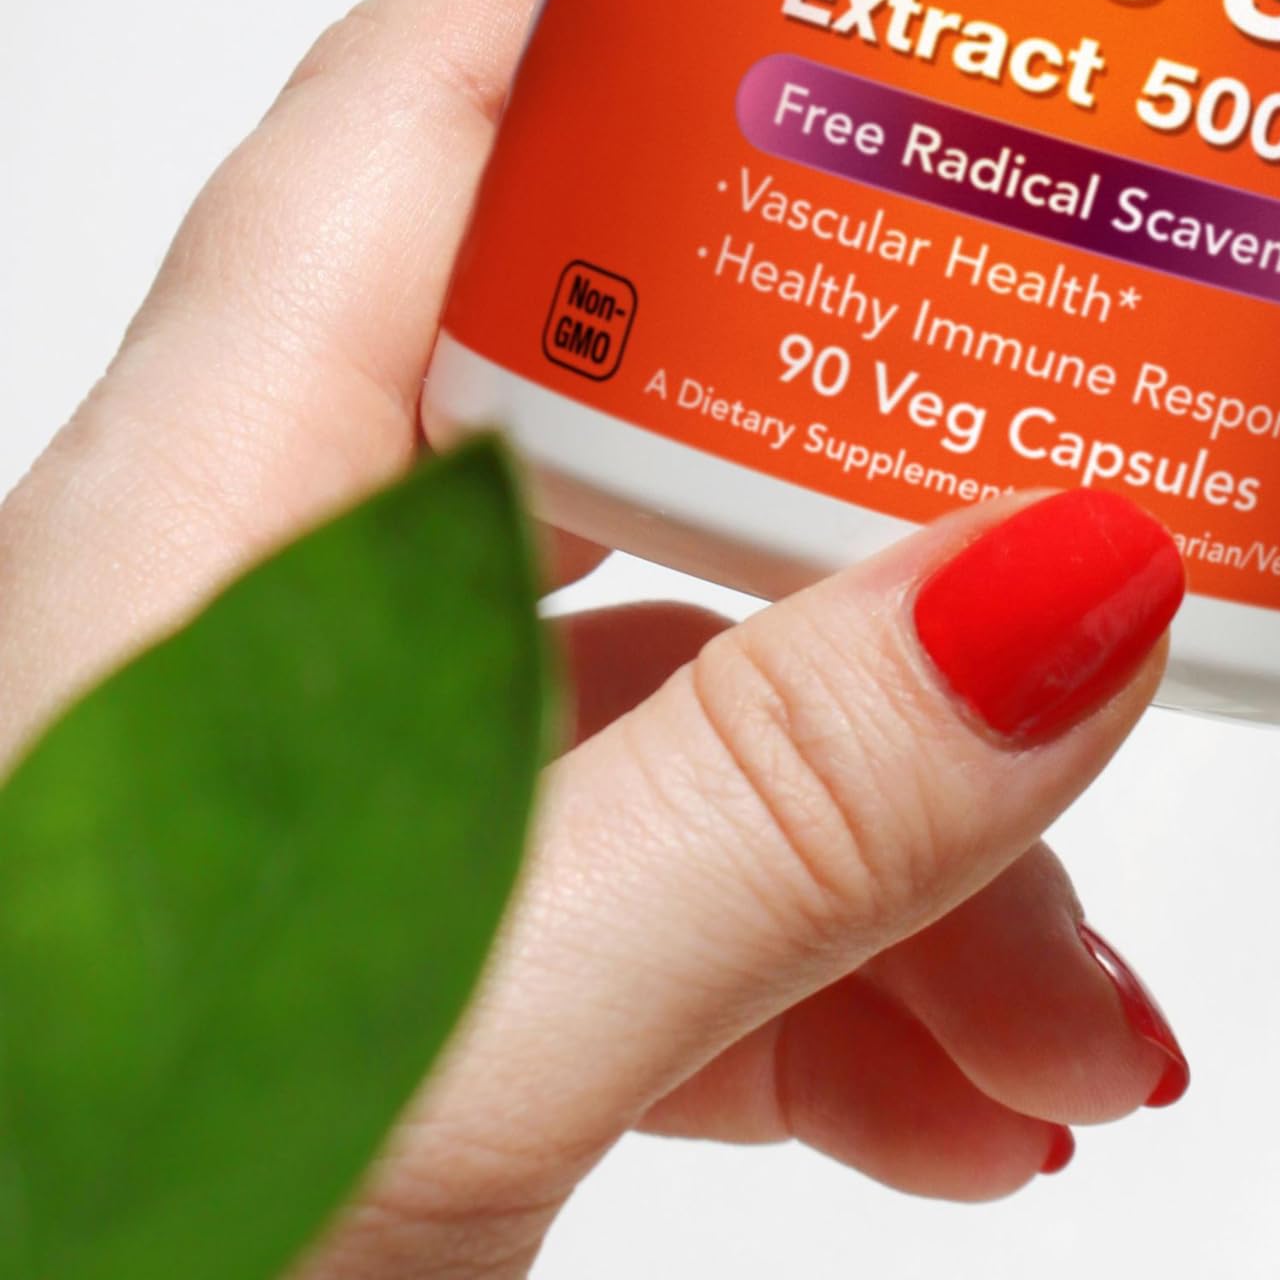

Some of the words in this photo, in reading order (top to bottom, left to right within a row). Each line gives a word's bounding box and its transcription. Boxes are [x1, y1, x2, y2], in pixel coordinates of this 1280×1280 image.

[772, 80, 886, 156] Free
[901, 122, 1101, 221] Radical
[740, 166, 932, 267] Vascular
[554, 316, 611, 364] GMO
[568, 275, 626, 320] Non-
[714, 234, 899, 340] Healthy
[912, 298, 1118, 397] Immune
[643, 368, 669, 401] A
[677, 378, 797, 451] Dietary
[778, 333, 852, 398] 90
[874, 361, 988, 455] Veg
[1007, 402, 1261, 511] Capsules
